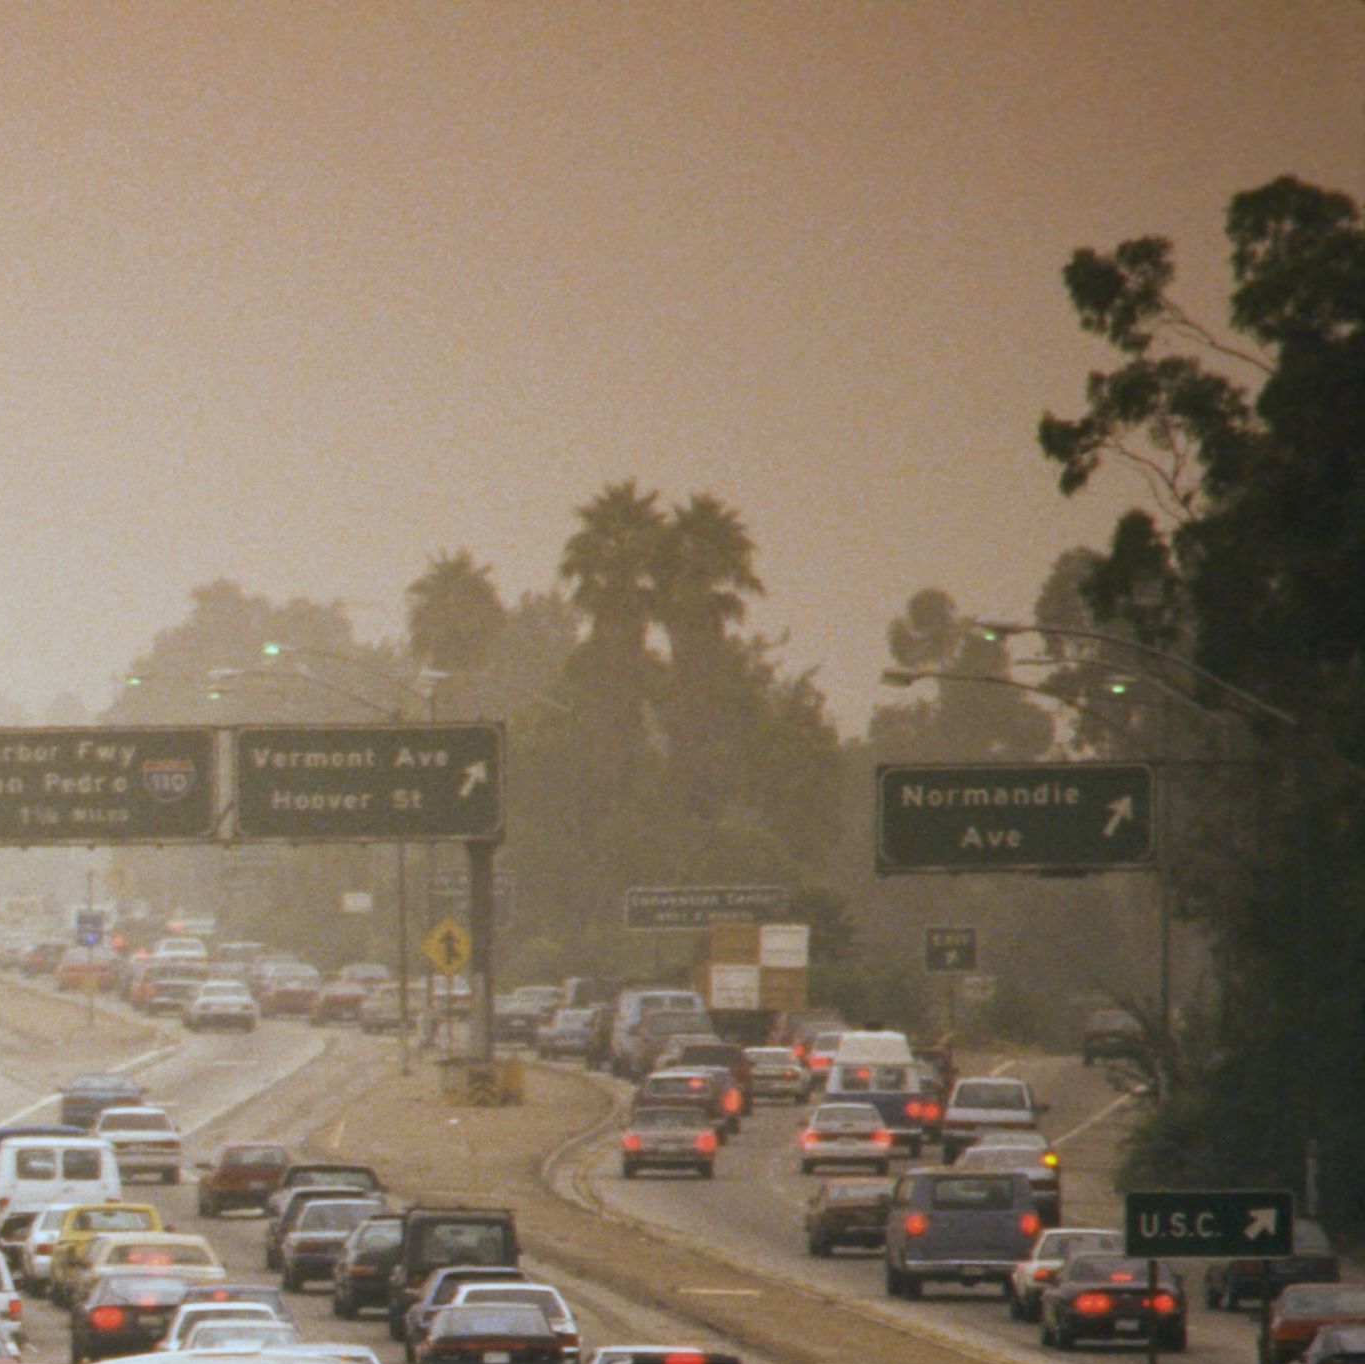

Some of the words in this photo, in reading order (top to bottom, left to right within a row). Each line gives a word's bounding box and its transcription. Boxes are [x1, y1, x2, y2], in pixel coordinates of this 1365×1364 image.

[77, 741, 136, 768] Fwy
[250, 747, 374, 768] Vermont
[395, 746, 449, 767] Ave
[43, 772, 128, 793] Pedro
[271, 789, 372, 809] Hoover
[391, 788, 422, 809] St
[901, 783, 1080, 807] Normandie
[960, 825, 1023, 847] Ave
[1140, 1211, 1222, 1238] U.S.C.
